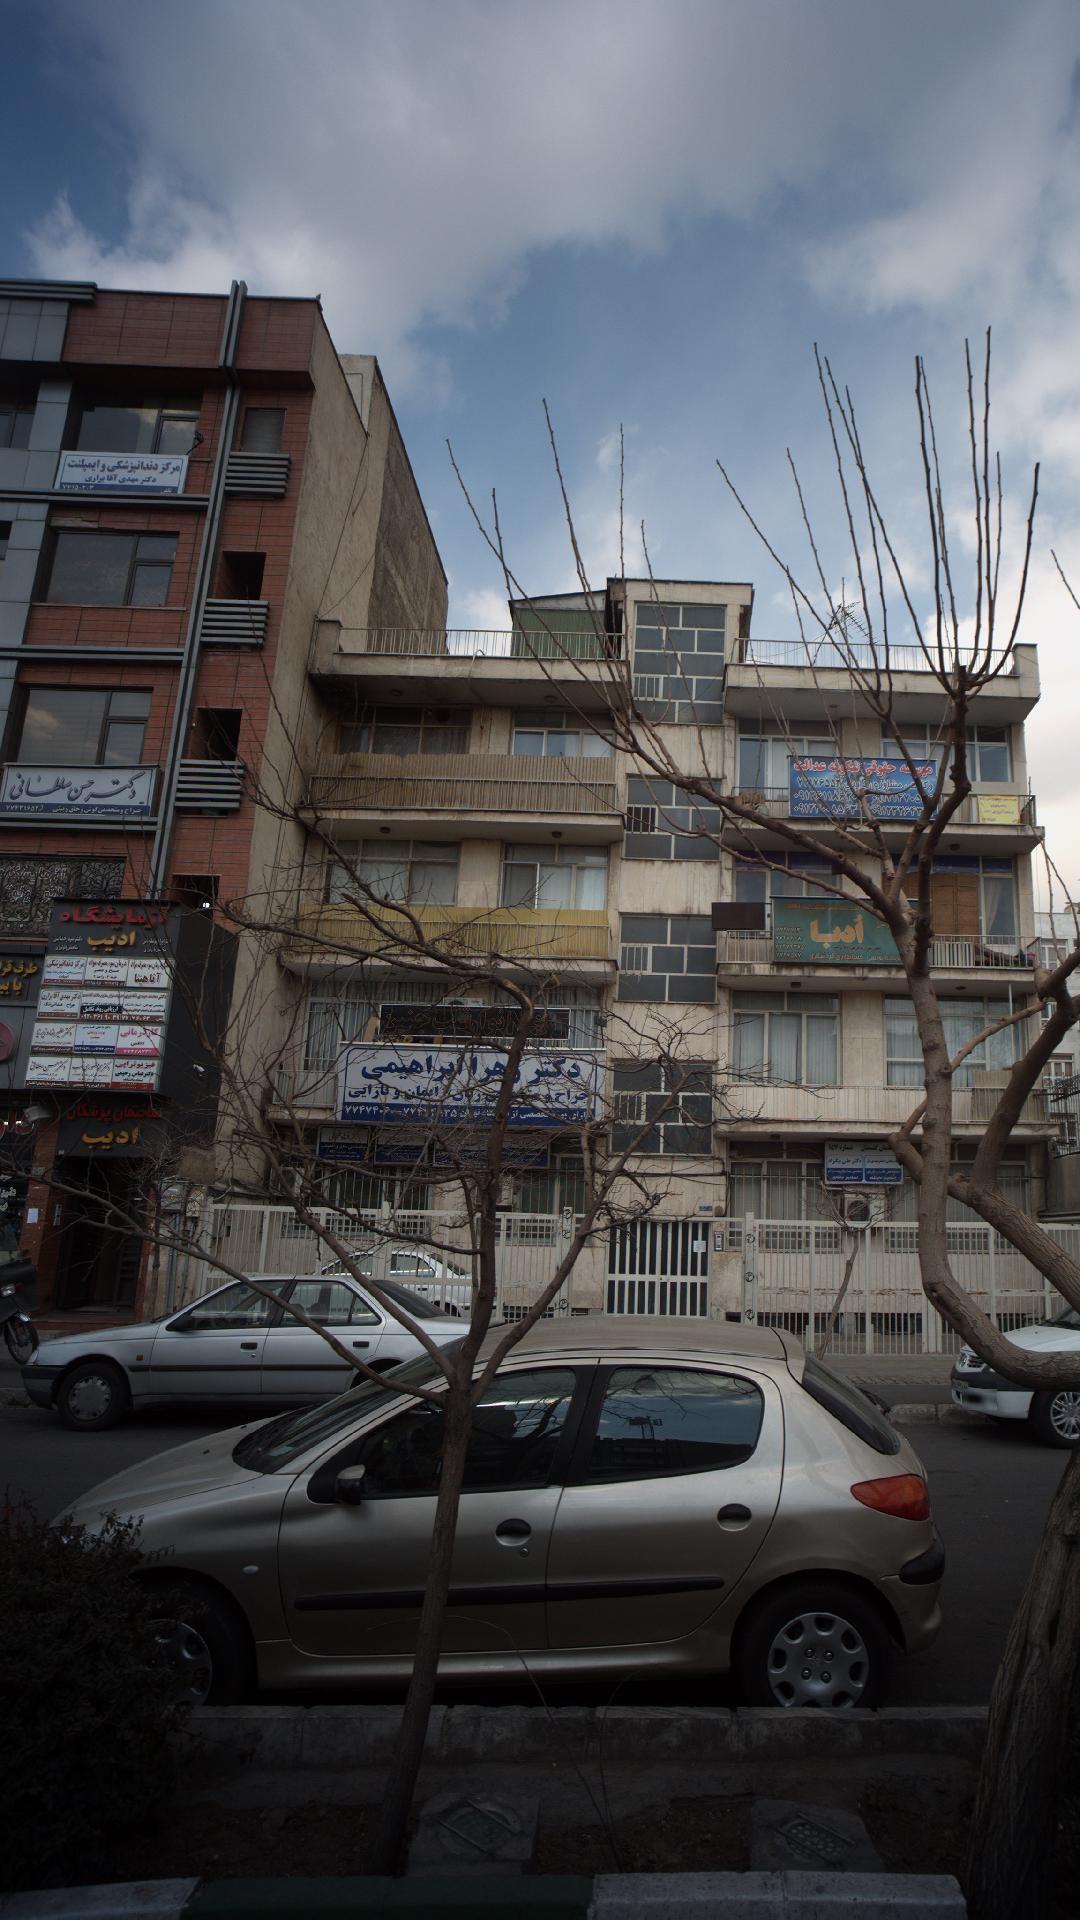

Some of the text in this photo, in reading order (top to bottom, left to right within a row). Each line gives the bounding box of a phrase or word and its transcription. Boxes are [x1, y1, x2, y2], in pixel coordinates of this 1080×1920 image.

[67, 459, 181, 474] مرکز دندانپزشکی و ایمپلنت
[141, 475, 157, 483] دکتر
[9, 771, 73, 801] سلطانی
[84, 770, 146, 803] دکتر
[87, 928, 136, 952] ادیب
[361, 1055, 464, 1080] ابراهیمی
[527, 1058, 581, 1084] دکتر
[81, 1126, 141, 1151] ادیب
